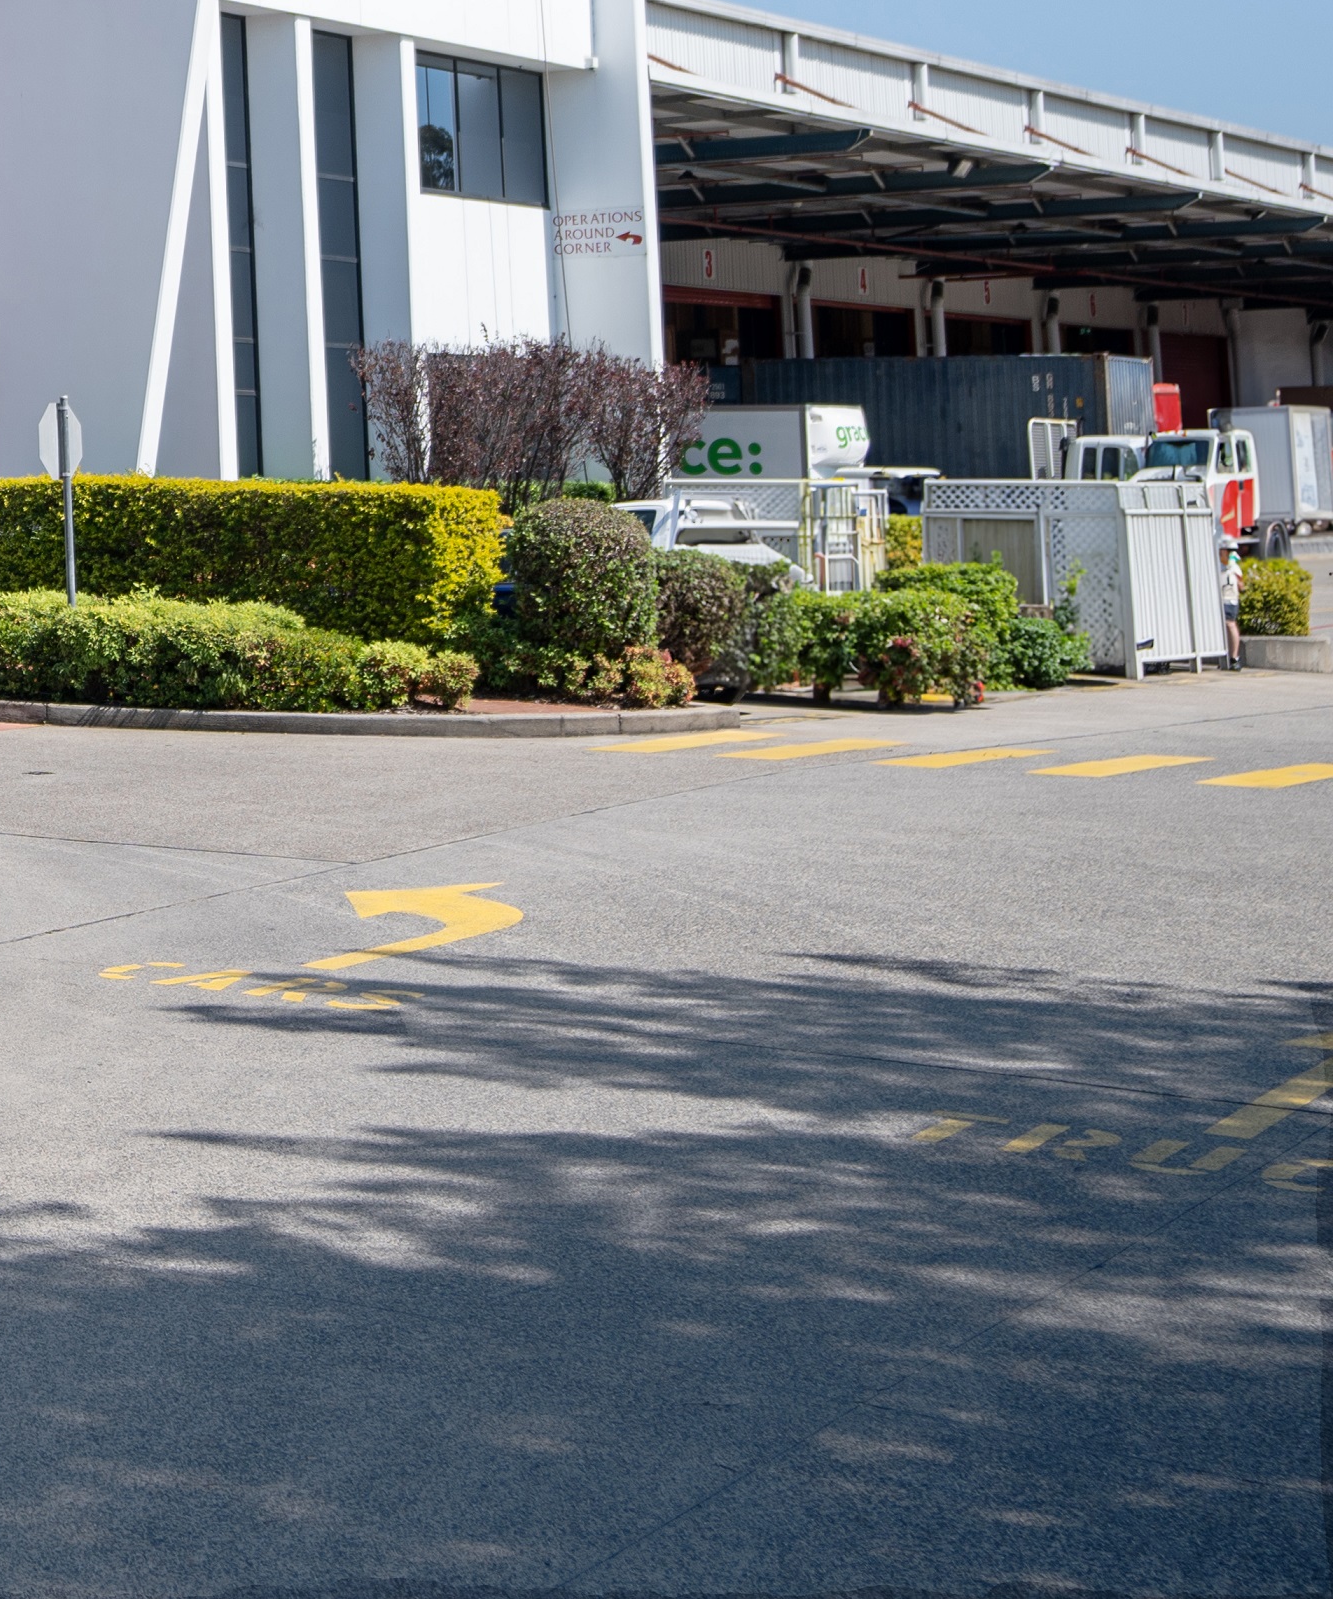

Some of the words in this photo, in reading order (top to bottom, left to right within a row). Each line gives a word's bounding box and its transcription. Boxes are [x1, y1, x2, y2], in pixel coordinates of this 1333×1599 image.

[553, 211, 642, 227] OPERATIONS
[554, 227, 615, 242] AROUND
[554, 242, 612, 255] CORNER
[705, 250, 713, 278] 3
[860, 268, 867, 294] 4
[984, 281, 991, 305] 5
[98, 961, 425, 1011] CARS
